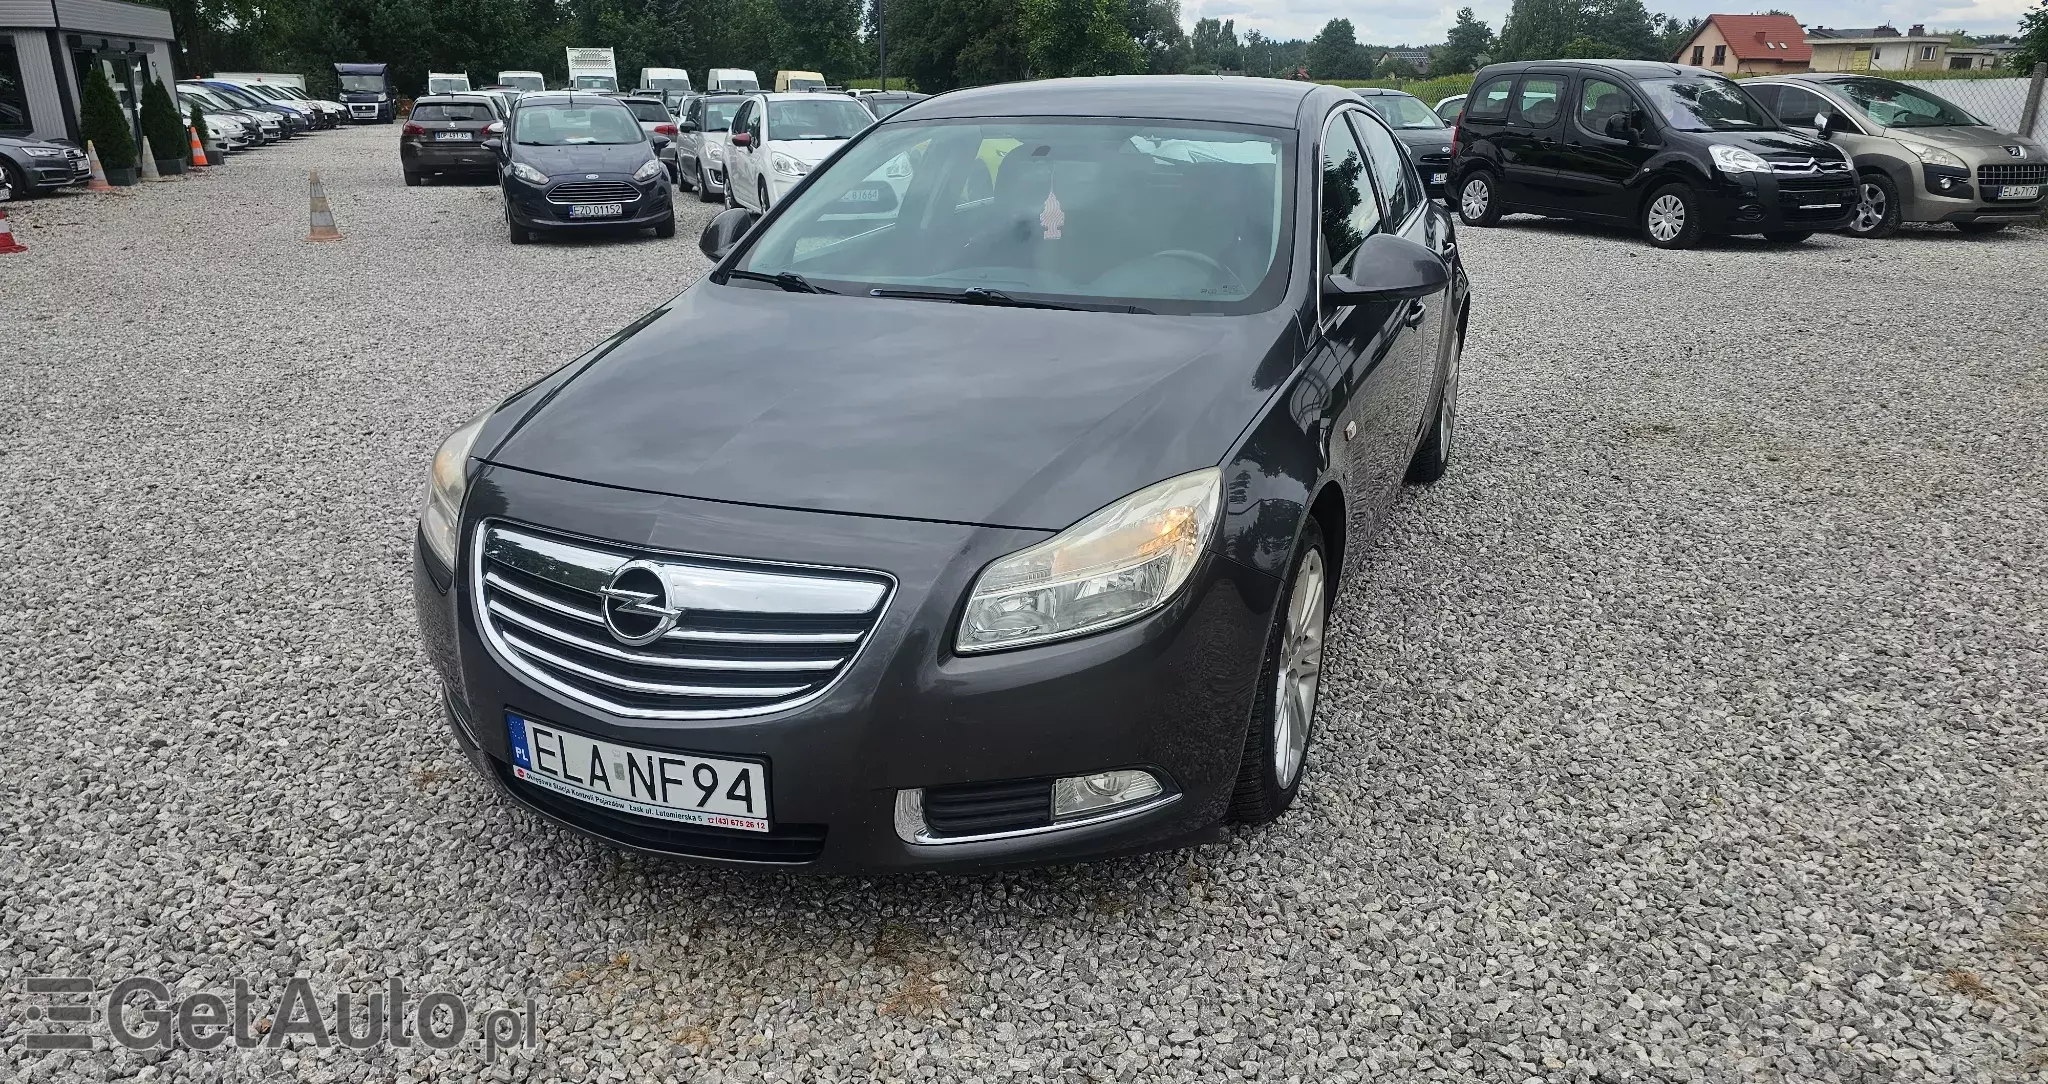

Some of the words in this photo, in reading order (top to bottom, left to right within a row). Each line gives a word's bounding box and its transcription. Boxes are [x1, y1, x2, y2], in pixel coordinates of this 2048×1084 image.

[593, 204, 621, 214] 01152
[515, 746, 529, 762] PL
[533, 727, 611, 792] ELA
[627, 752, 753, 813] NF94
[552, 782, 571, 794] Stacja
[571, 788, 594, 801] Kontroli
[595, 796, 625, 808] Pojazdów
[629, 803, 644, 813] Łask
[645, 807, 654, 815] ul.
[655, 809, 697, 821] Lutomierska
[715, 816, 729, 827] (43)
[730, 819, 744, 827] 675
[746, 820, 755, 828] 26
[756, 822, 766, 830] 12
